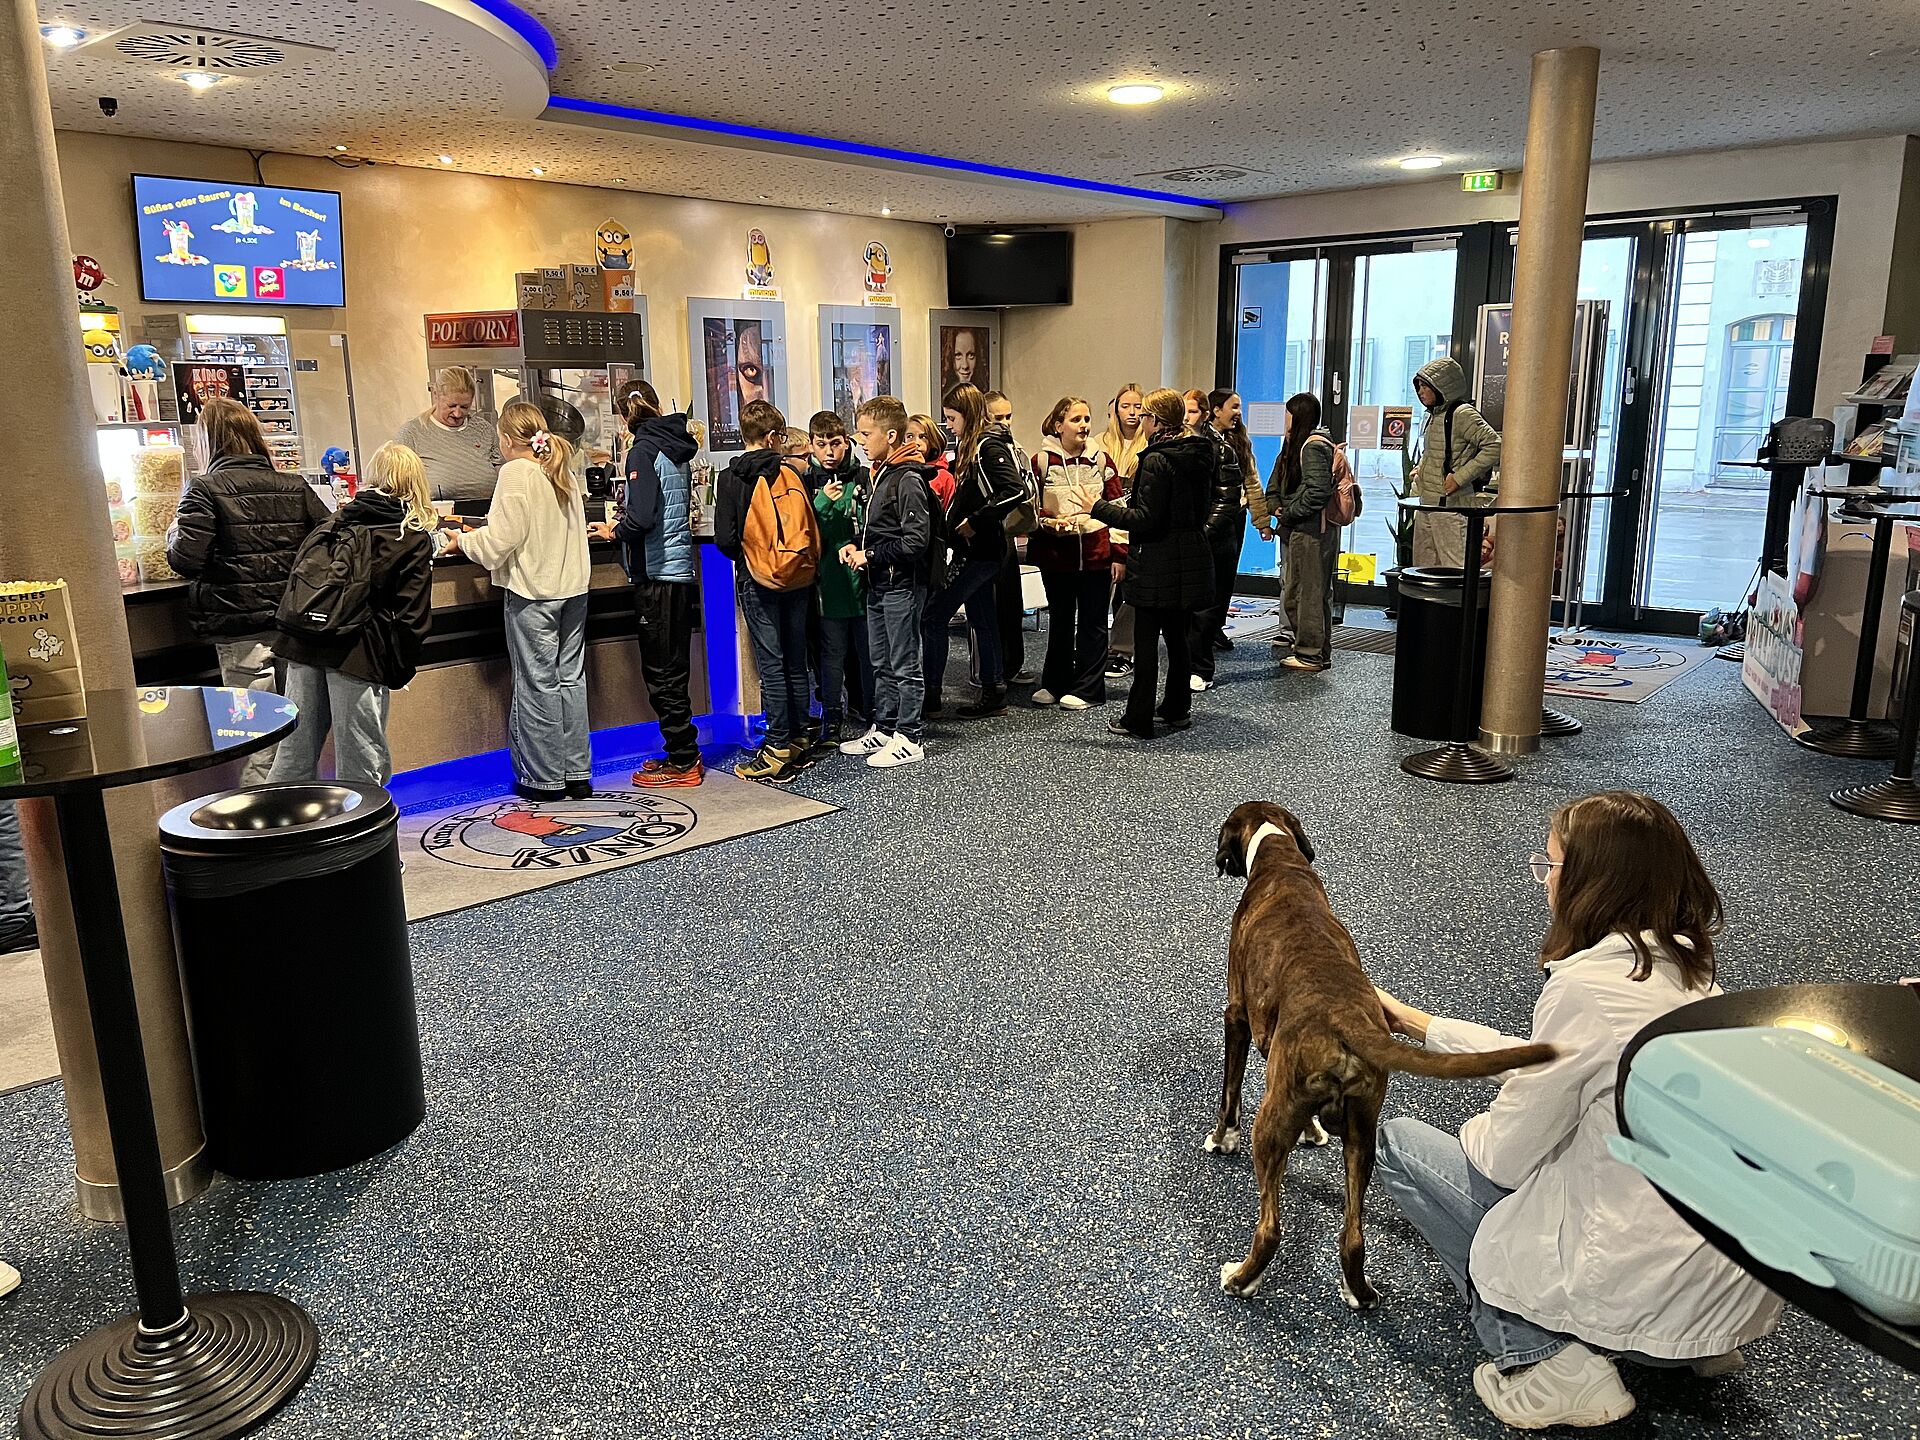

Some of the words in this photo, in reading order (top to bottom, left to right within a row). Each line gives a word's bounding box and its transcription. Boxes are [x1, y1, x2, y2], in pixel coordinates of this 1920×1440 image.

[175, 197, 197, 208] oder
[197, 190, 231, 203] Saures
[77, 272, 95, 288] m
[614, 288, 630, 297] 8,50
[431, 319, 512, 341] POPCORN
[511, 821, 687, 868] KINO
